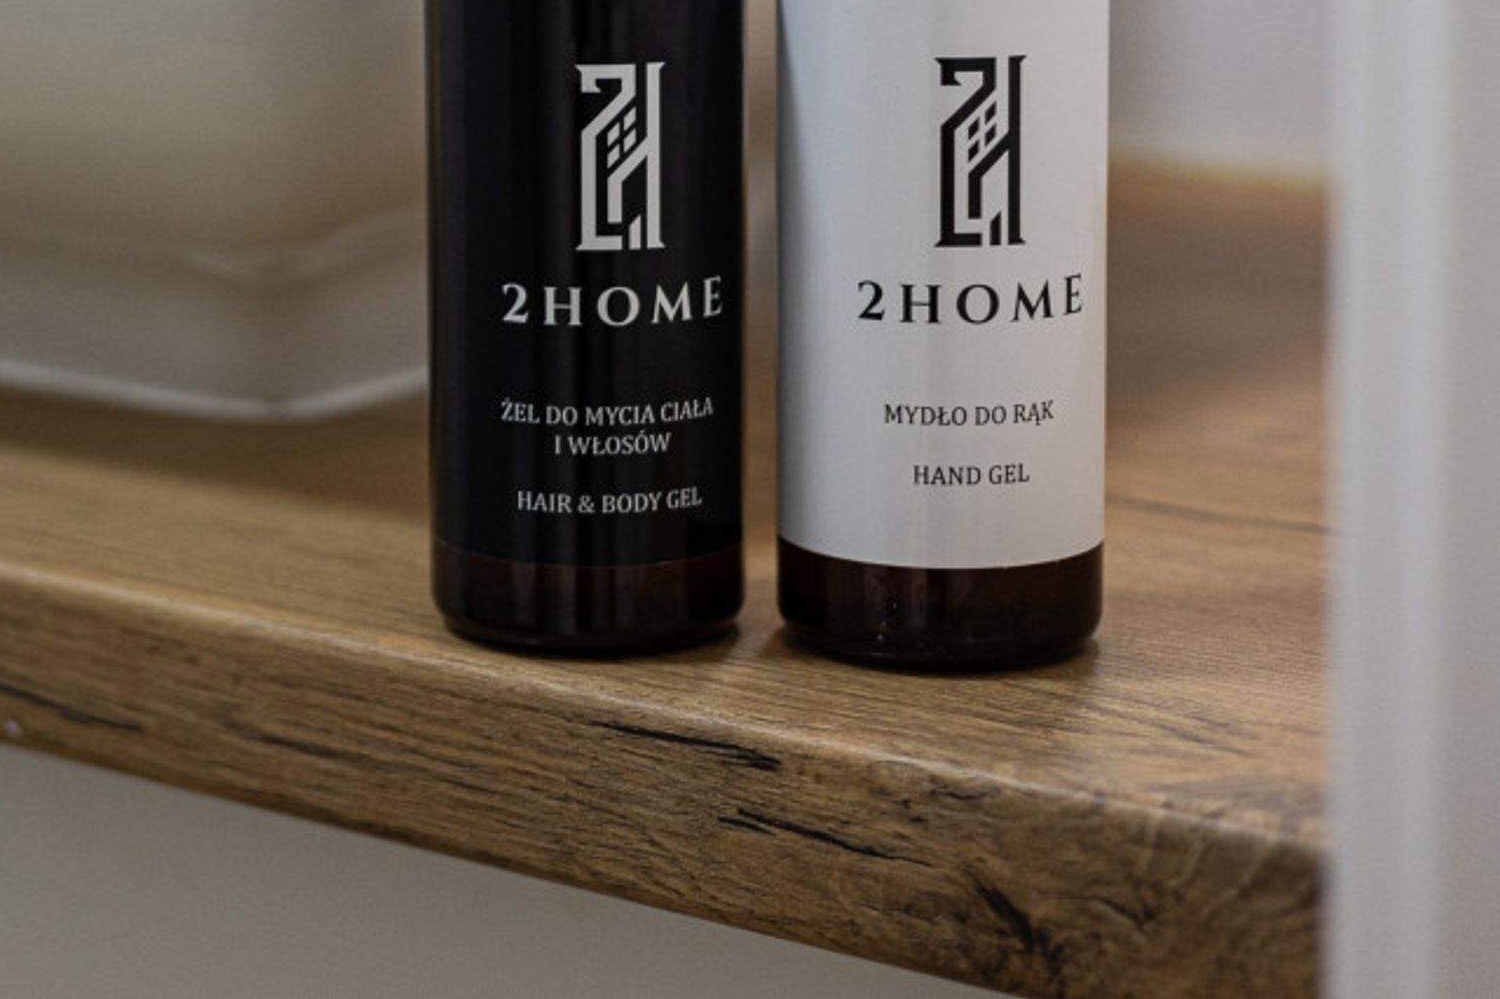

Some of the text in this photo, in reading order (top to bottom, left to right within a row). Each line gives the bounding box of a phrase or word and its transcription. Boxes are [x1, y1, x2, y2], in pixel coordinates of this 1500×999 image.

[501, 275, 722, 327] 2HOME
[856, 273, 1083, 325] 2HOME
[501, 396, 713, 426] ŻEL DO MYCIA CIAŁA
[884, 399, 1054, 427] MYDŁO DO RĄK
[553, 429, 672, 455] I WŁOSÓW
[913, 463, 1030, 486] HAND GEL
[517, 486, 703, 514] HAIR & BODY GEL
